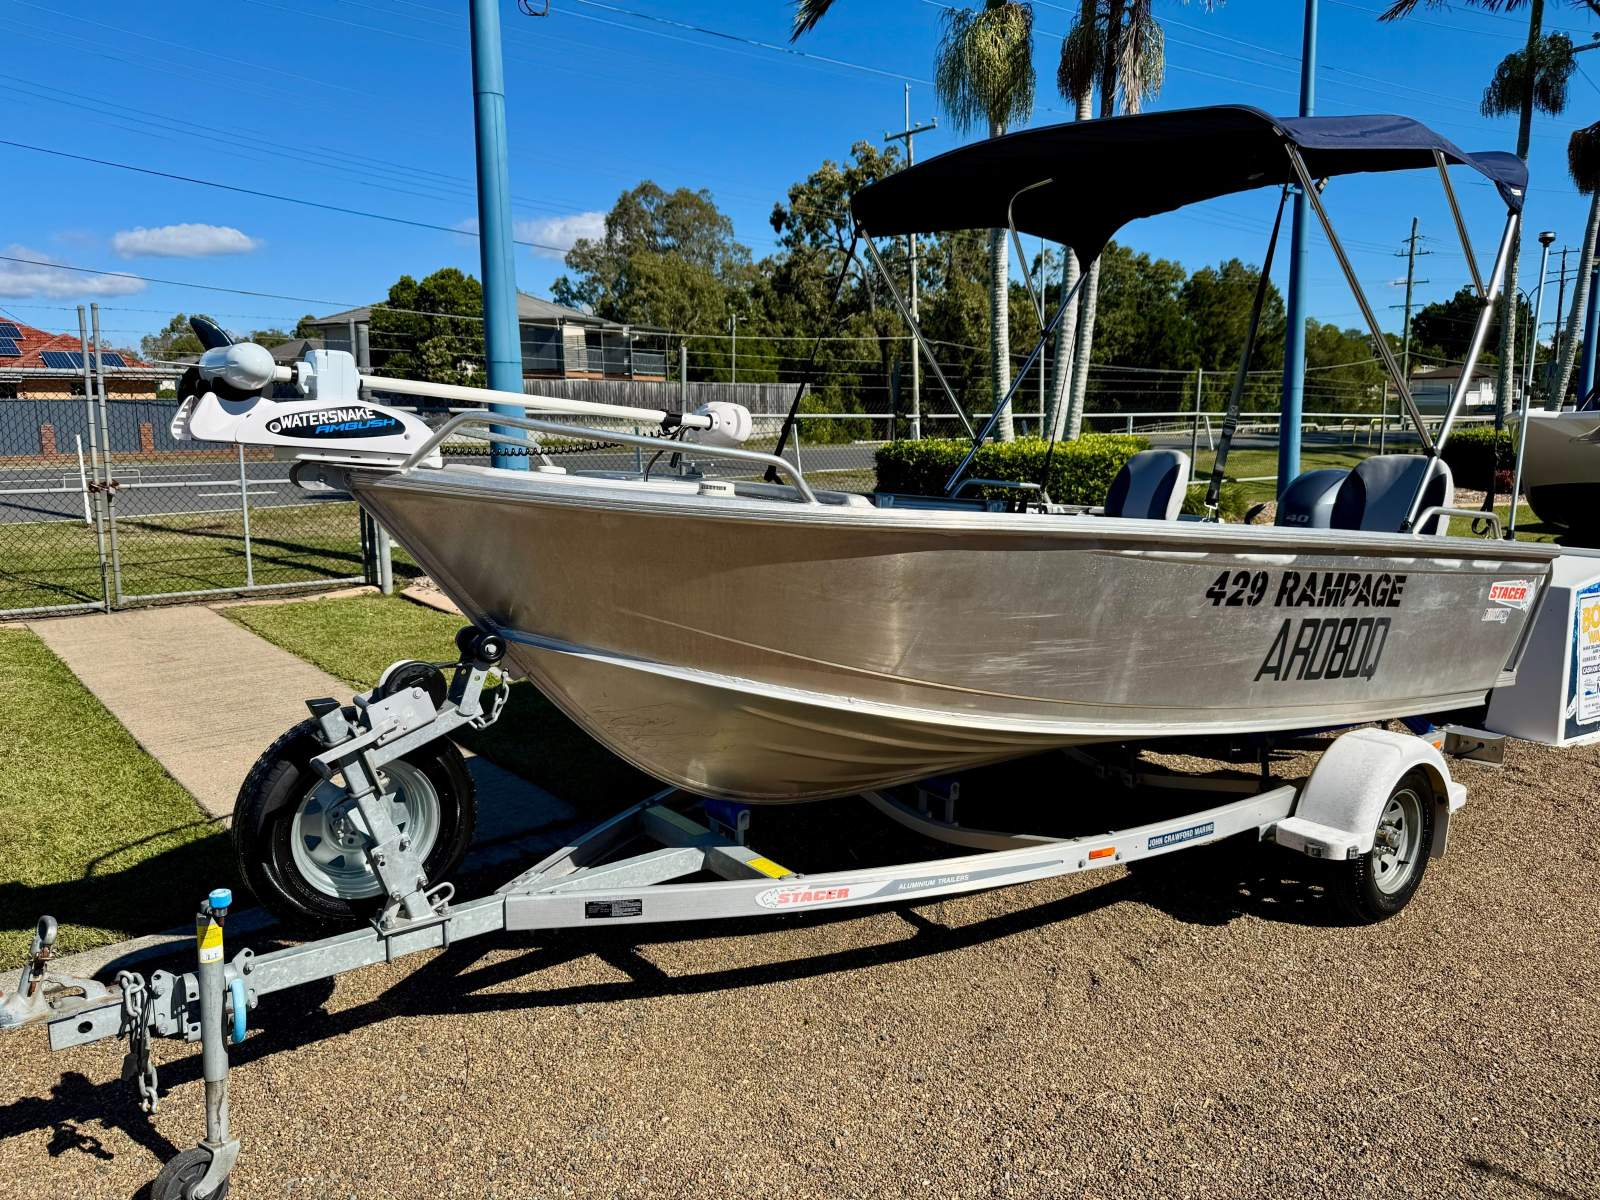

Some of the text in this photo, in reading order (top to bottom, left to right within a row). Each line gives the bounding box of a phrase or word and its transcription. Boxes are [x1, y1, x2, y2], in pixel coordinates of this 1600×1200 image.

[280, 408, 375, 429] WATERSNAKE
[315, 419, 395, 434] AMBUSH
[1285, 514, 1309, 522] 40
[1205, 571, 1407, 608] 429 RAMPAGE
[1490, 585, 1527, 600] STACER
[1149, 823, 1214, 847] JOHN CRAWFORD MARINE
[899, 874, 969, 890] ALUMINIUM TRAILERS
[777, 888, 849, 904] STACER
